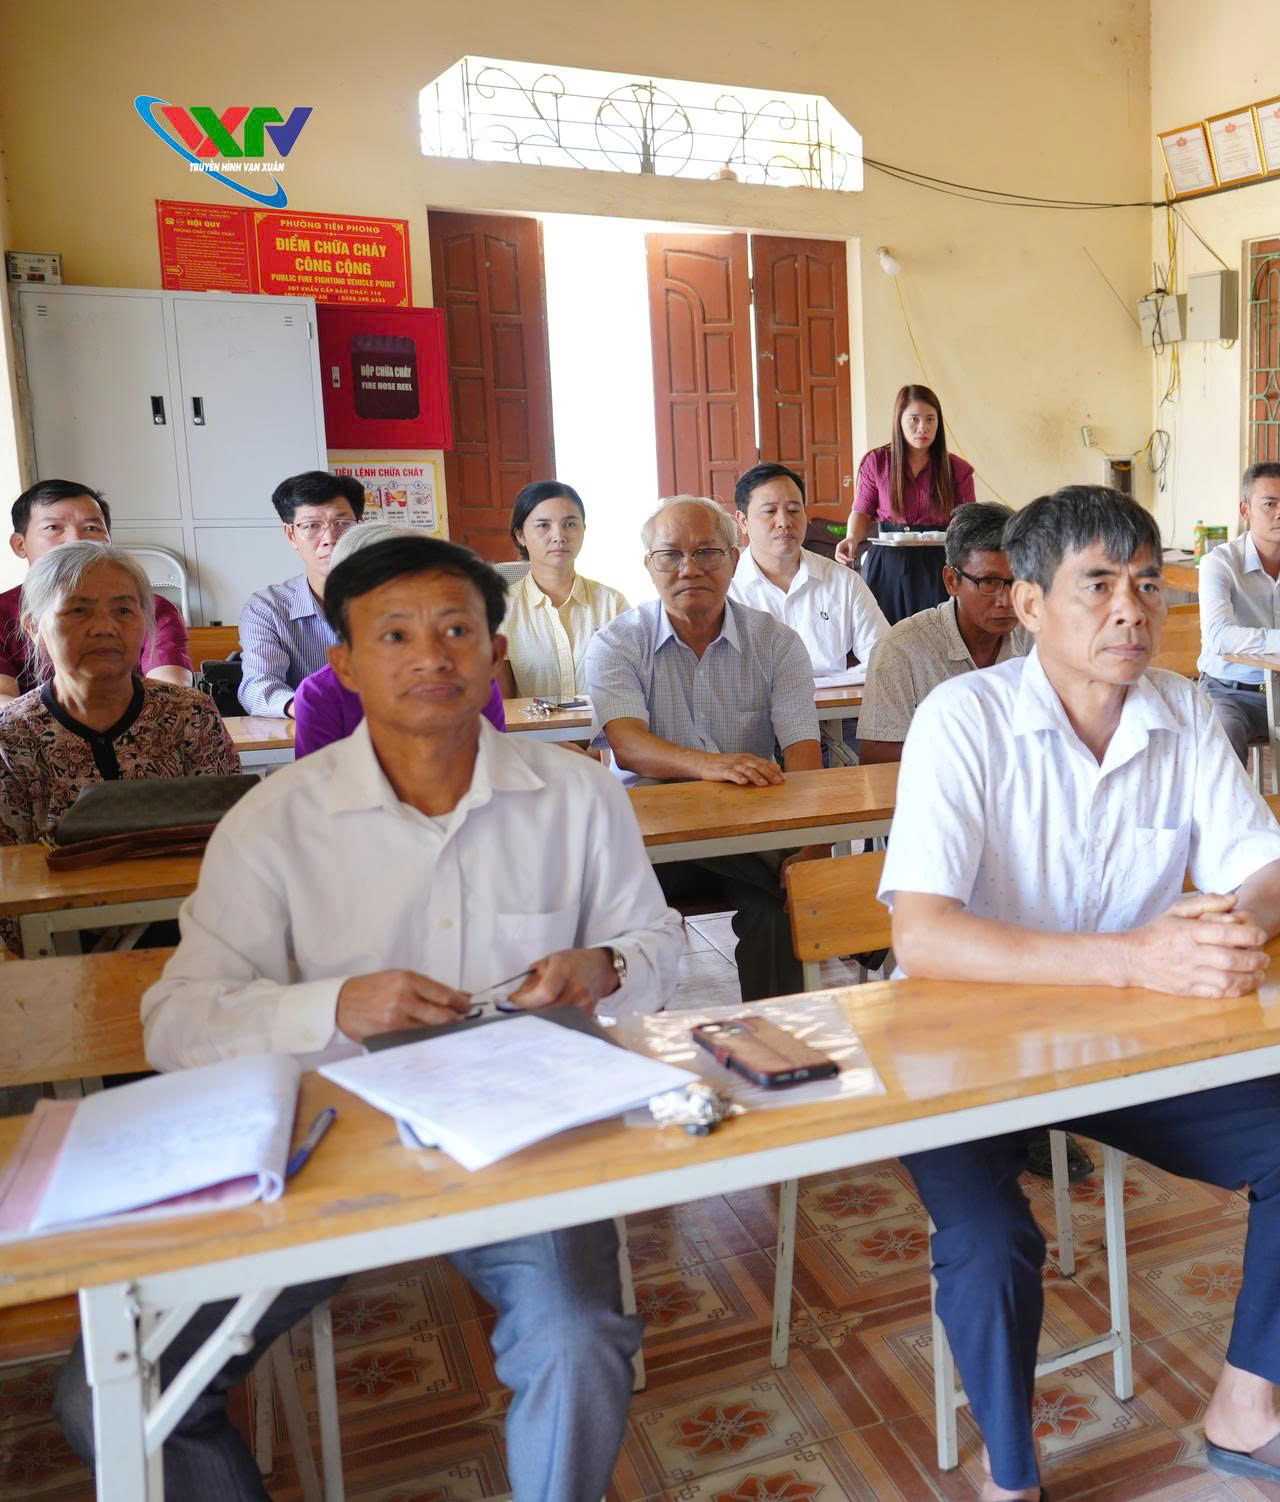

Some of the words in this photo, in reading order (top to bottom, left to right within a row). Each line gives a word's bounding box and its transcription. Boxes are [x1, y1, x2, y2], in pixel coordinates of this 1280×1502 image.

[346, 224, 380, 233] PHONG
[275, 234, 311, 252] ĐIỂM
[314, 239, 350, 255] CHỮA
[353, 241, 386, 257] CHÁY
[295, 256, 332, 273] CÔNG
[335, 259, 371, 277] CỘNG
[271, 273, 297, 282] PUBLIC
[298, 275, 313, 283] FIRE
[314, 276, 346, 285] FIGHTING
[347, 278, 374, 287] VEHICLE
[375, 280, 395, 288] POINT
[360, 364, 374, 378] HỘP
[375, 364, 394, 377] CHỮA
[394, 365, 411, 378] CHÁY
[362, 382, 376, 390] FIRE
[378, 382, 396, 390] HOSE
[397, 383, 413, 391] REEL
[378, 466, 401, 477] CHỮA
[403, 467, 424, 477] CHÁY
